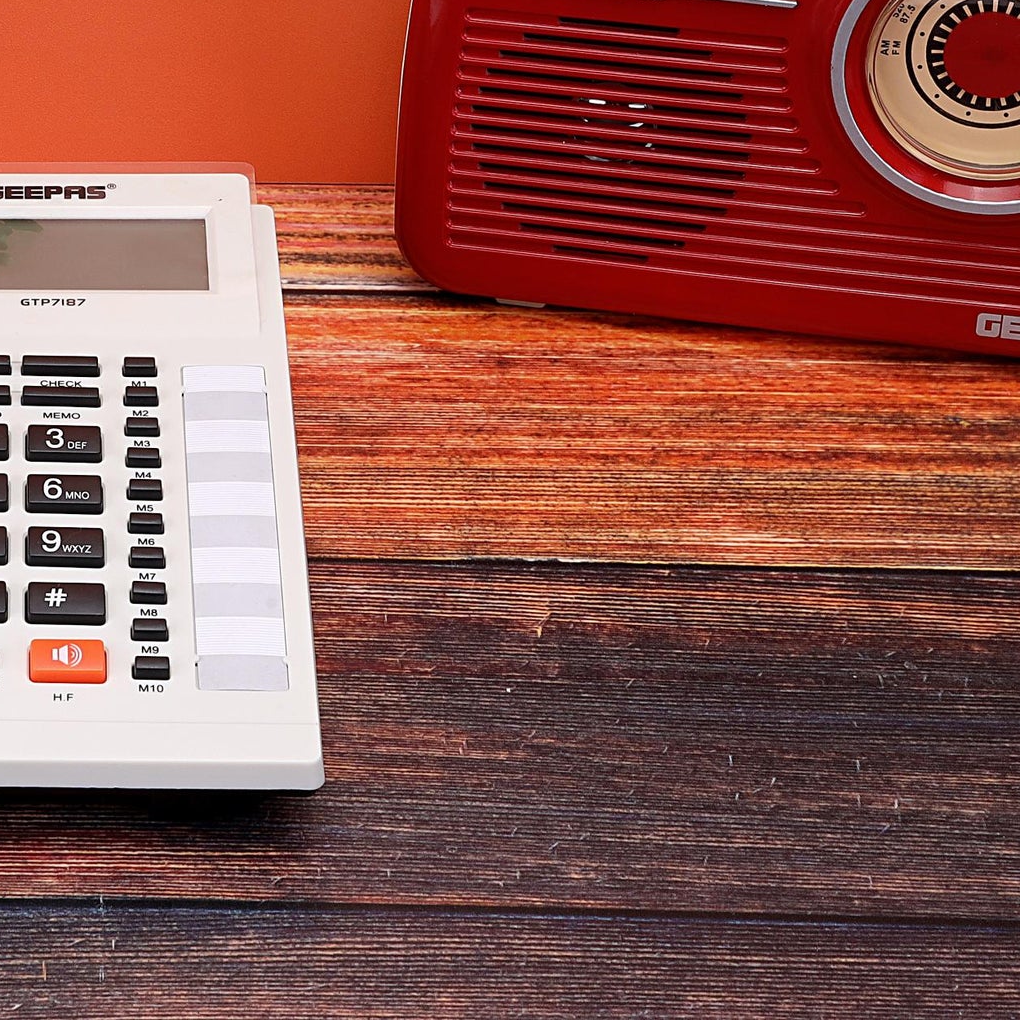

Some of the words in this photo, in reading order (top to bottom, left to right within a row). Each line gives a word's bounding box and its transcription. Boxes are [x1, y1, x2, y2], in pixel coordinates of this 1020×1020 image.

[899, 4, 916, 24] 87.5
[880, 40, 891, 56] AM
[892, 40, 901, 55] FM
[20, 298, 86, 307] GTP7187
[40, 379, 82, 388] CHECK
[42, 412, 81, 420] MEMO
[45, 428, 65, 449] 3
[67, 440, 87, 450] DEF
[42, 477, 63, 500] 6
[65, 490, 90, 500] MNO
[136, 504, 154, 512] M5
[41, 530, 61, 553] 9
[62, 543, 92, 554] WXYZ
[137, 538, 155, 546] M6
[140, 609, 158, 617] M8
[141, 646, 160, 654] M9
[138, 684, 164, 693] M10
